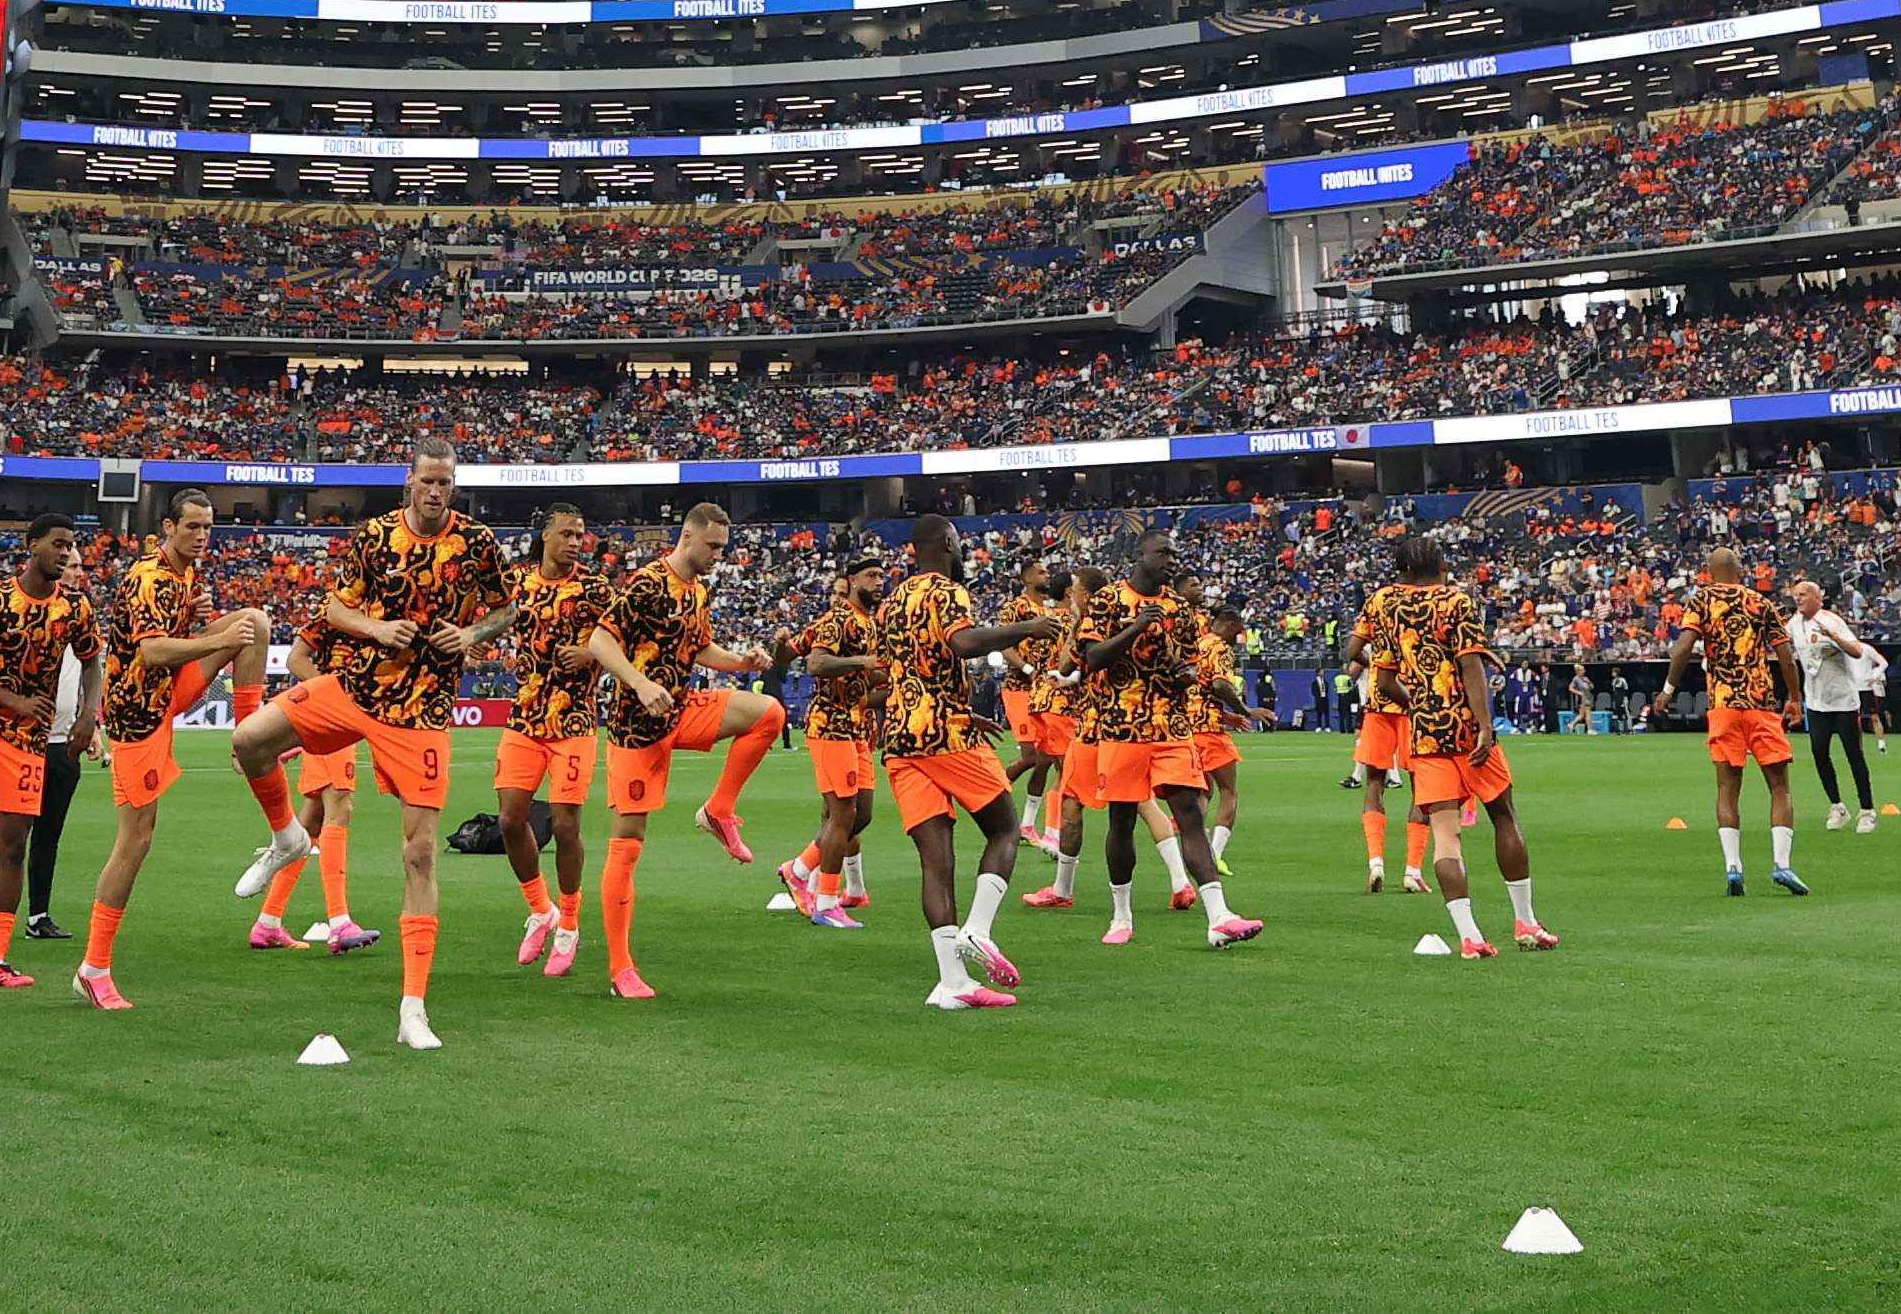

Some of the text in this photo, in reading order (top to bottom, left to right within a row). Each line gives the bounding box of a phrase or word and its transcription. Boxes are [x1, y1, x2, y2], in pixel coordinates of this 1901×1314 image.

[405, 5, 463, 19] FOOTBALL
[674, 0, 735, 17] FOOTBALL
[1648, 30, 1704, 52] FOOTBALL
[1414, 64, 1466, 85] FOOTBALL
[1198, 95, 1245, 113] FOOTBALL
[987, 118, 1036, 137] FOOTBALL
[94, 128, 146, 146] FOOTBALL
[324, 138, 373, 154] FOOTBALL
[549, 136, 599, 153] FOOTBALL
[771, 134, 818, 151] FOOTBALL
[1321, 168, 1377, 190] FOOTBALL
[534, 270, 569, 285] FIFA
[570, 270, 627, 284] WORLD
[1526, 415, 1590, 435] FOOTBALL
[1250, 434, 1311, 454] FOOTBALL
[1000, 452, 1055, 468] FOOTBALL
[226, 465, 289, 482] FOOTBALL
[500, 469, 559, 482] FOOTBALL
[760, 462, 816, 479] FOOTBALL
[423, 747, 439, 781] 9
[566, 754, 581, 783] 5
[17, 763, 43, 793] 25
